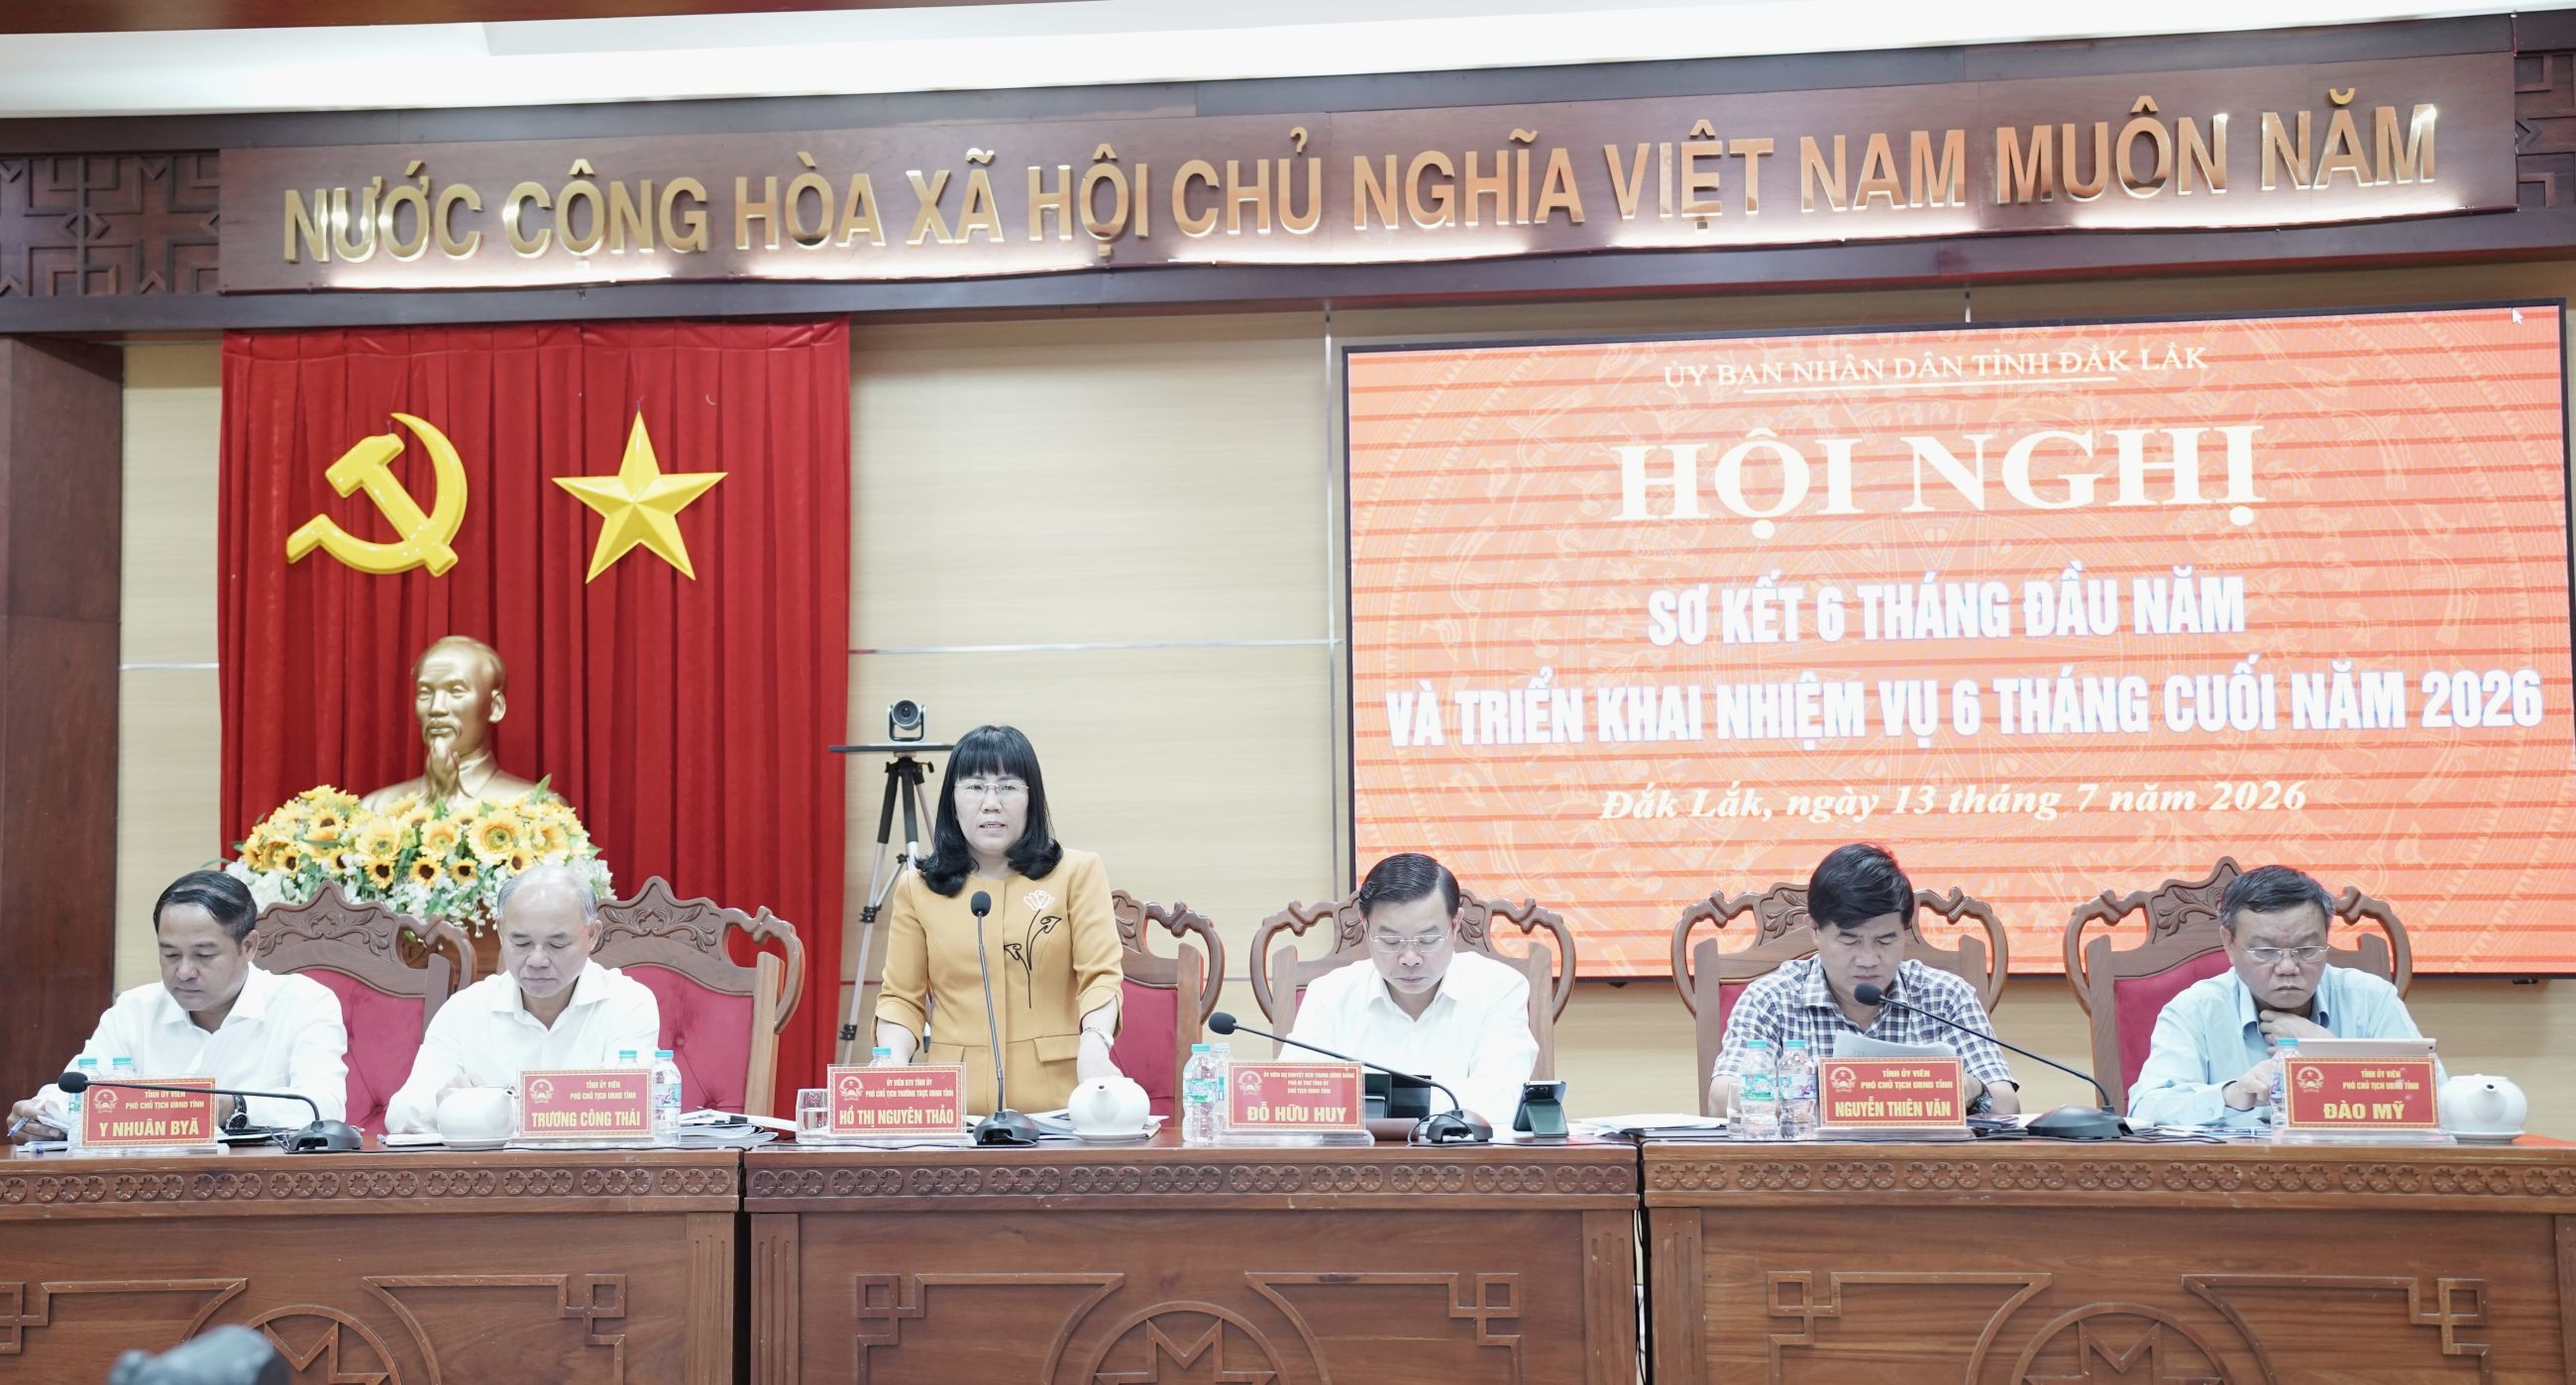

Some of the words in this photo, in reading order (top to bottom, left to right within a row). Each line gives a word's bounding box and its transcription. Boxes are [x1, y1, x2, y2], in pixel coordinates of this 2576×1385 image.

[284, 160, 483, 262] NƯỚC
[502, 159, 707, 269] CỘNG
[736, 152, 886, 250] HÒA
[906, 147, 1005, 245] XÃ
[1027, 143, 1149, 257] HỘI
[1172, 126, 1322, 238] CHỦ
[1353, 128, 1585, 230] NGHĨA
[1604, 119, 1773, 229] VIỆT
[1800, 129, 1966, 212] NAM
[1995, 95, 2228, 204] MUÔN
[2261, 87, 2437, 191] NĂM
[1664, 360, 1709, 387] ỦY
[1716, 361, 1789, 386] BAN
[1790, 353, 1884, 383] NHÂN
[1893, 350, 1963, 380] DÂN
[1971, 349, 2050, 376] TỈNH
[2058, 344, 2131, 373] ĐẮK
[2140, 341, 2209, 372] LẮK
[1617, 428, 1865, 540] HỘI
[1899, 422, 2266, 530] NGHỊ
[1648, 583, 1709, 647] SƠ
[1721, 570, 1806, 645] KẾT
[1816, 586, 1847, 642] 6
[1857, 571, 2011, 641] THÁNG
[2021, 560, 2119, 637] ĐẦU
[2132, 565, 2246, 635] NĂM
[1386, 680, 1446, 747] VÀ
[1454, 666, 1584, 745] TRIỂN
[1597, 684, 1702, 743] KHAI
[1716, 671, 1866, 751] NHIỆM
[1878, 680, 1939, 750] VỤ
[1951, 679, 1982, 736] 6
[1992, 665, 2149, 735] THÁNG
[2163, 654, 2277, 732] CUỐI
[2292, 660, 2406, 730] NĂM
[2420, 669, 2543, 728] 2026
[1599, 782, 1679, 820] Đắk
[1690, 780, 1773, 820] Lắk,
[1785, 786, 1879, 823] ngày
[1891, 785, 1937, 814] 13
[1948, 784, 2062, 821] tháng
[2077, 783, 2100, 812] 7
[2108, 783, 2197, 811] năm
[2208, 780, 2308, 811] 2026
[580, 1109, 612, 1127] CÔNG
[614, 1108, 641, 1126] THÁI
[857, 1109, 875, 1127] THỊ
[878, 1106, 922, 1124] NGUYÊN
[925, 1104, 954, 1124] THẢO
[1247, 1101, 1269, 1121] ĐỖ
[1274, 1104, 1309, 1121] HỮU
[1314, 1107, 1346, 1122] HUY
[1835, 1096, 1884, 1117] NGUYỄN
[1886, 1098, 1922, 1117] THIÊN
[1925, 1098, 1951, 1117] VĂN
[2322, 1100, 2366, 1119] ĐÀO
[2372, 1100, 2405, 1119] MỸ
[99, 1121, 108, 1137] Y
[112, 1118, 166, 1137] NHUÂN
[169, 1117, 199, 1136] BYĂ
